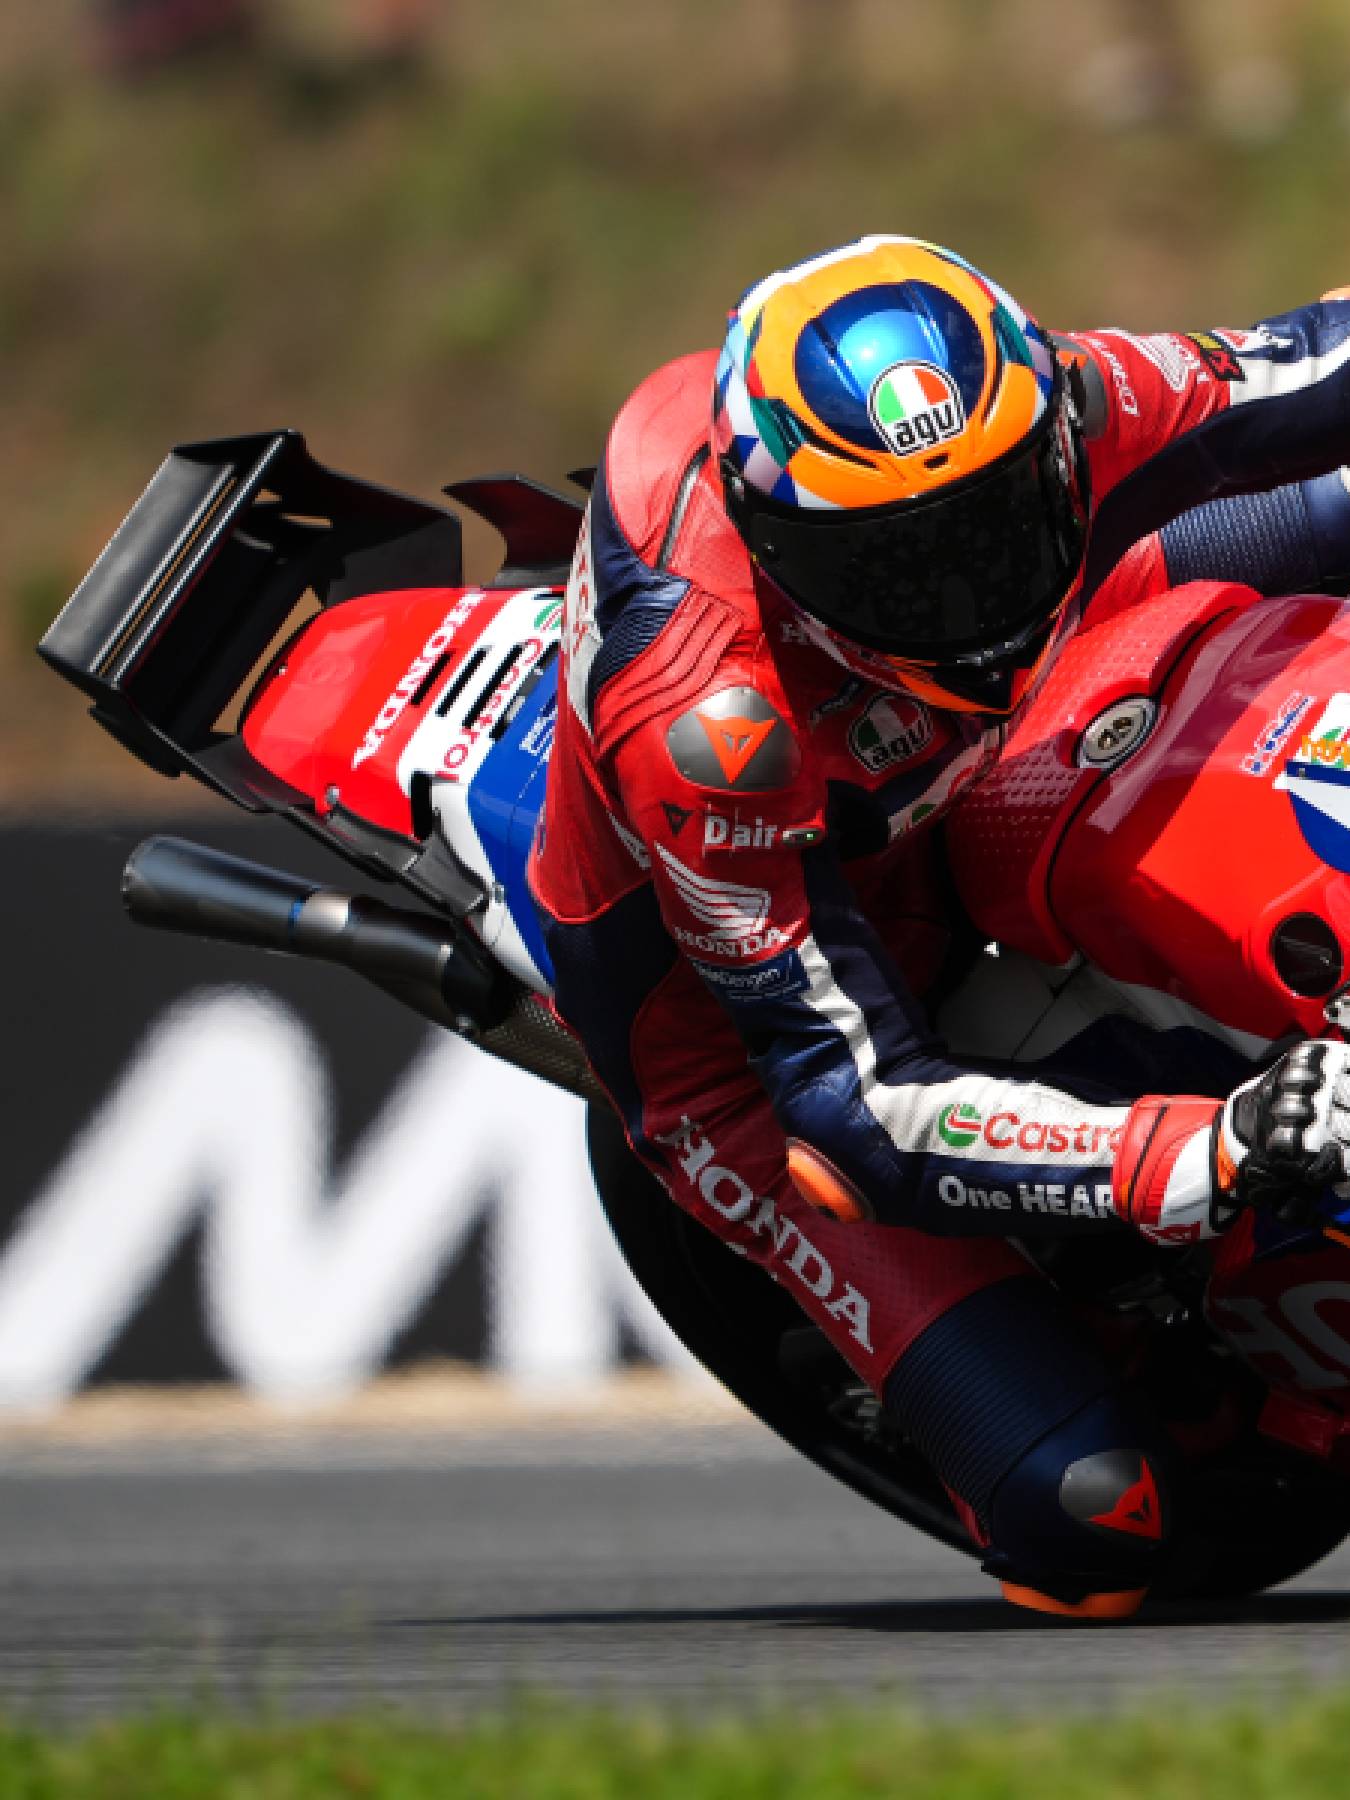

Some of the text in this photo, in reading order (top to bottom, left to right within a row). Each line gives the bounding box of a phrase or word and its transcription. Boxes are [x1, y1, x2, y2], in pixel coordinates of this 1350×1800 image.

[351, 588, 487, 770] HONDA
[673, 924, 791, 957] HONDA
[983, 1112, 1122, 1152] Castr
[938, 1175, 1114, 1218] One HEAR
[654, 1114, 874, 1355] HONDA
